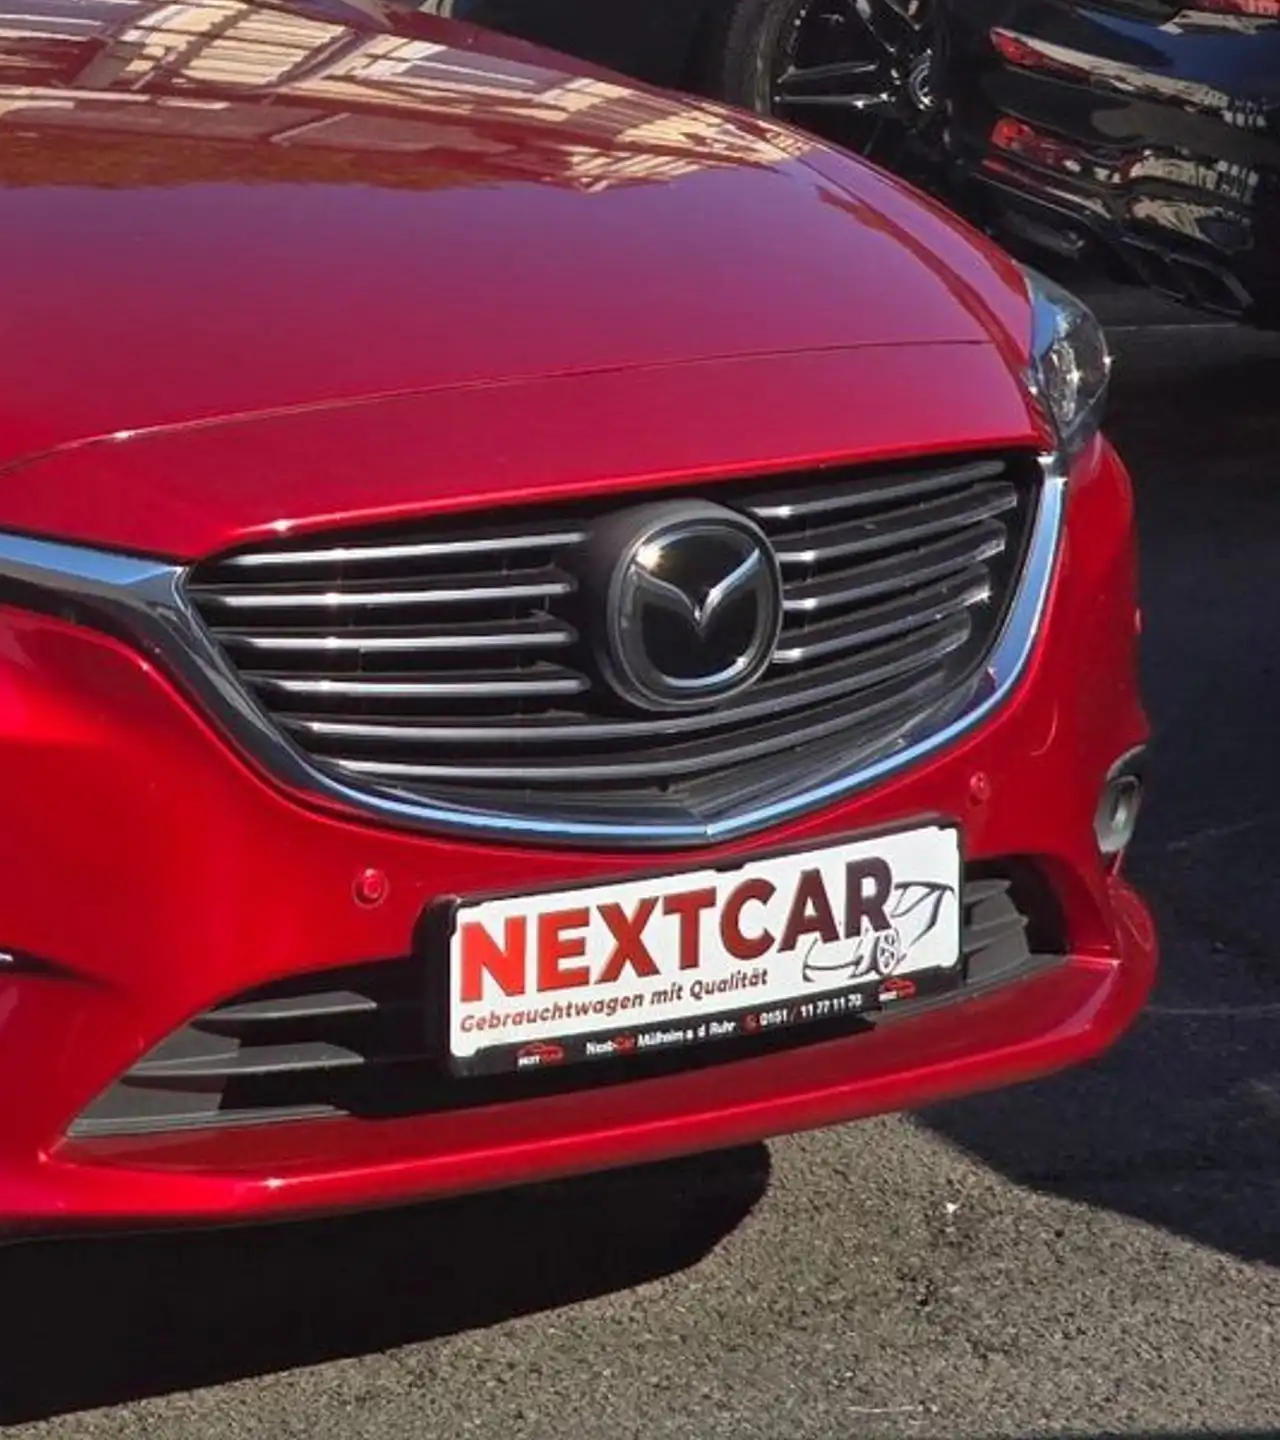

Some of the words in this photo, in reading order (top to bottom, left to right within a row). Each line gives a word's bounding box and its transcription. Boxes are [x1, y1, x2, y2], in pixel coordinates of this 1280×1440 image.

[460, 856, 894, 1003] NEXTCAR
[459, 993, 644, 1033] Gebrauchtwagen
[649, 980, 684, 1006] mit
[689, 968, 768, 1002] Qualität
[709, 1020, 736, 1035] Ruhr
